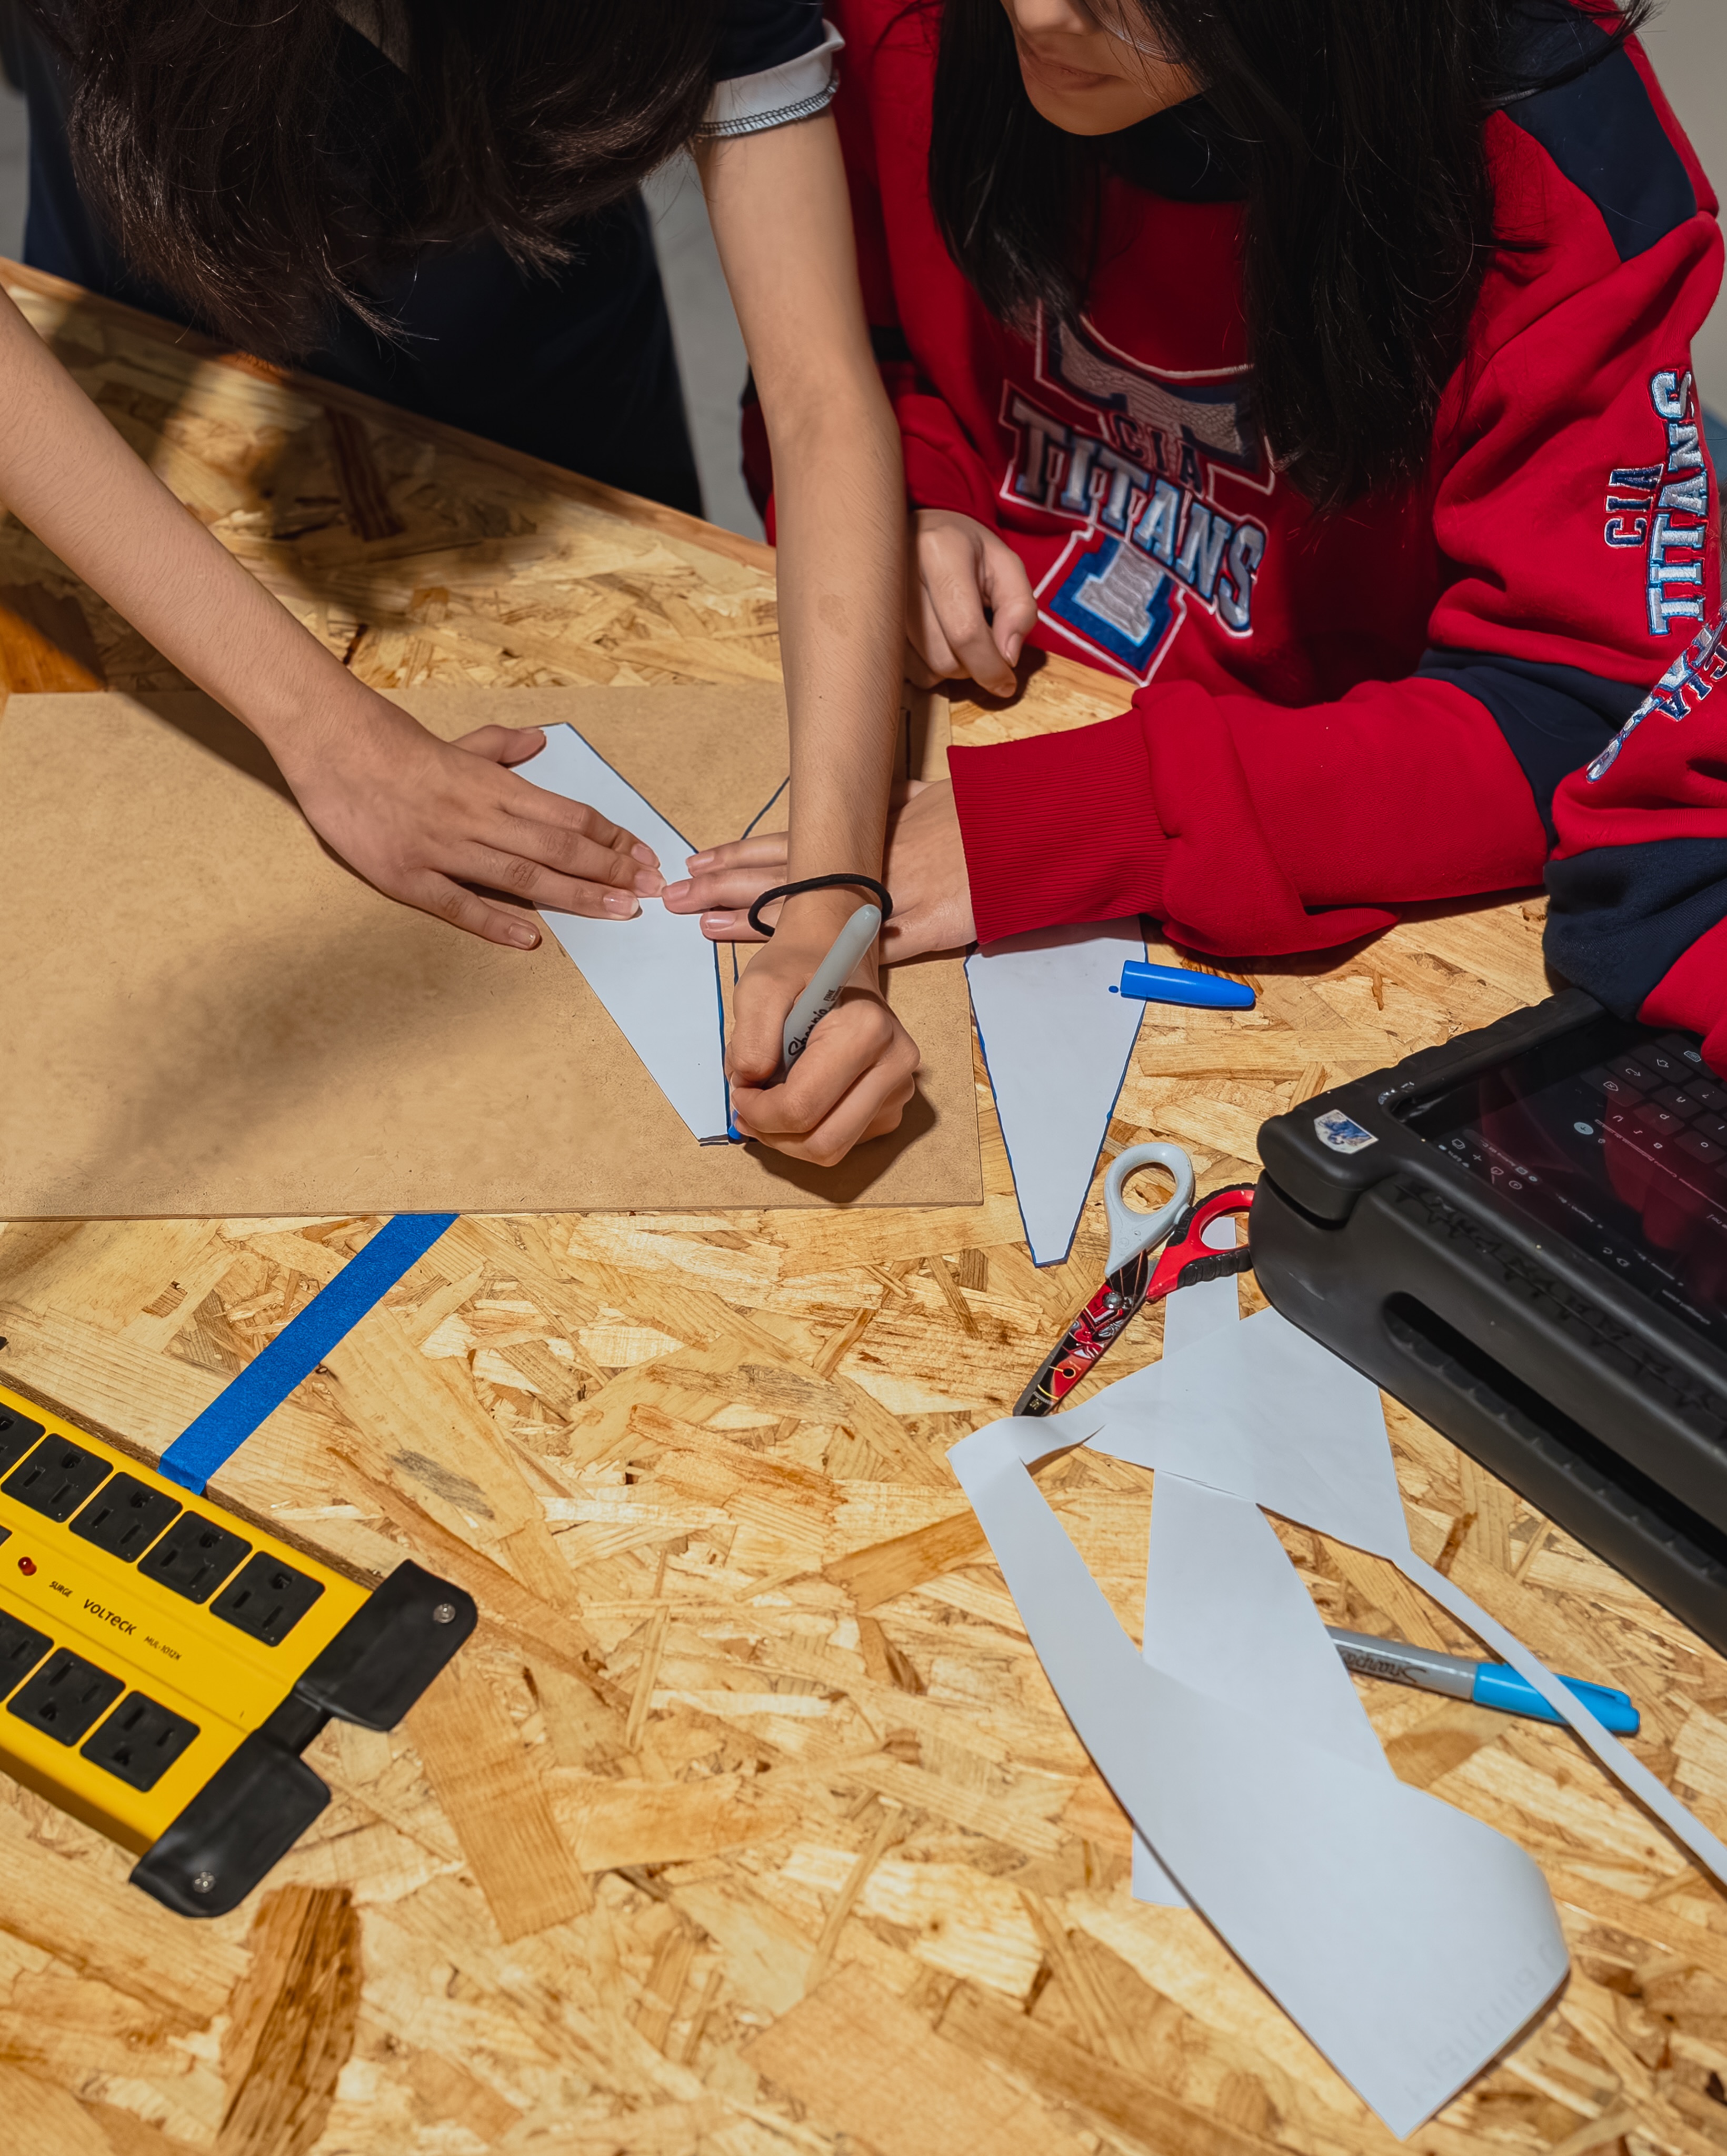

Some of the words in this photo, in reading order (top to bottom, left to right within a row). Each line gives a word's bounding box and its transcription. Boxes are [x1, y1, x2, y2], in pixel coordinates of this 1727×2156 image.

[1110, 412, 1204, 497] CIA
[1012, 395, 1264, 627] TITANS
[1605, 464, 1664, 547] CIA
[1648, 371, 1708, 635] TITANS
[823, 989, 836, 1002] FINE
[49, 1581, 73, 1598] SURGE
